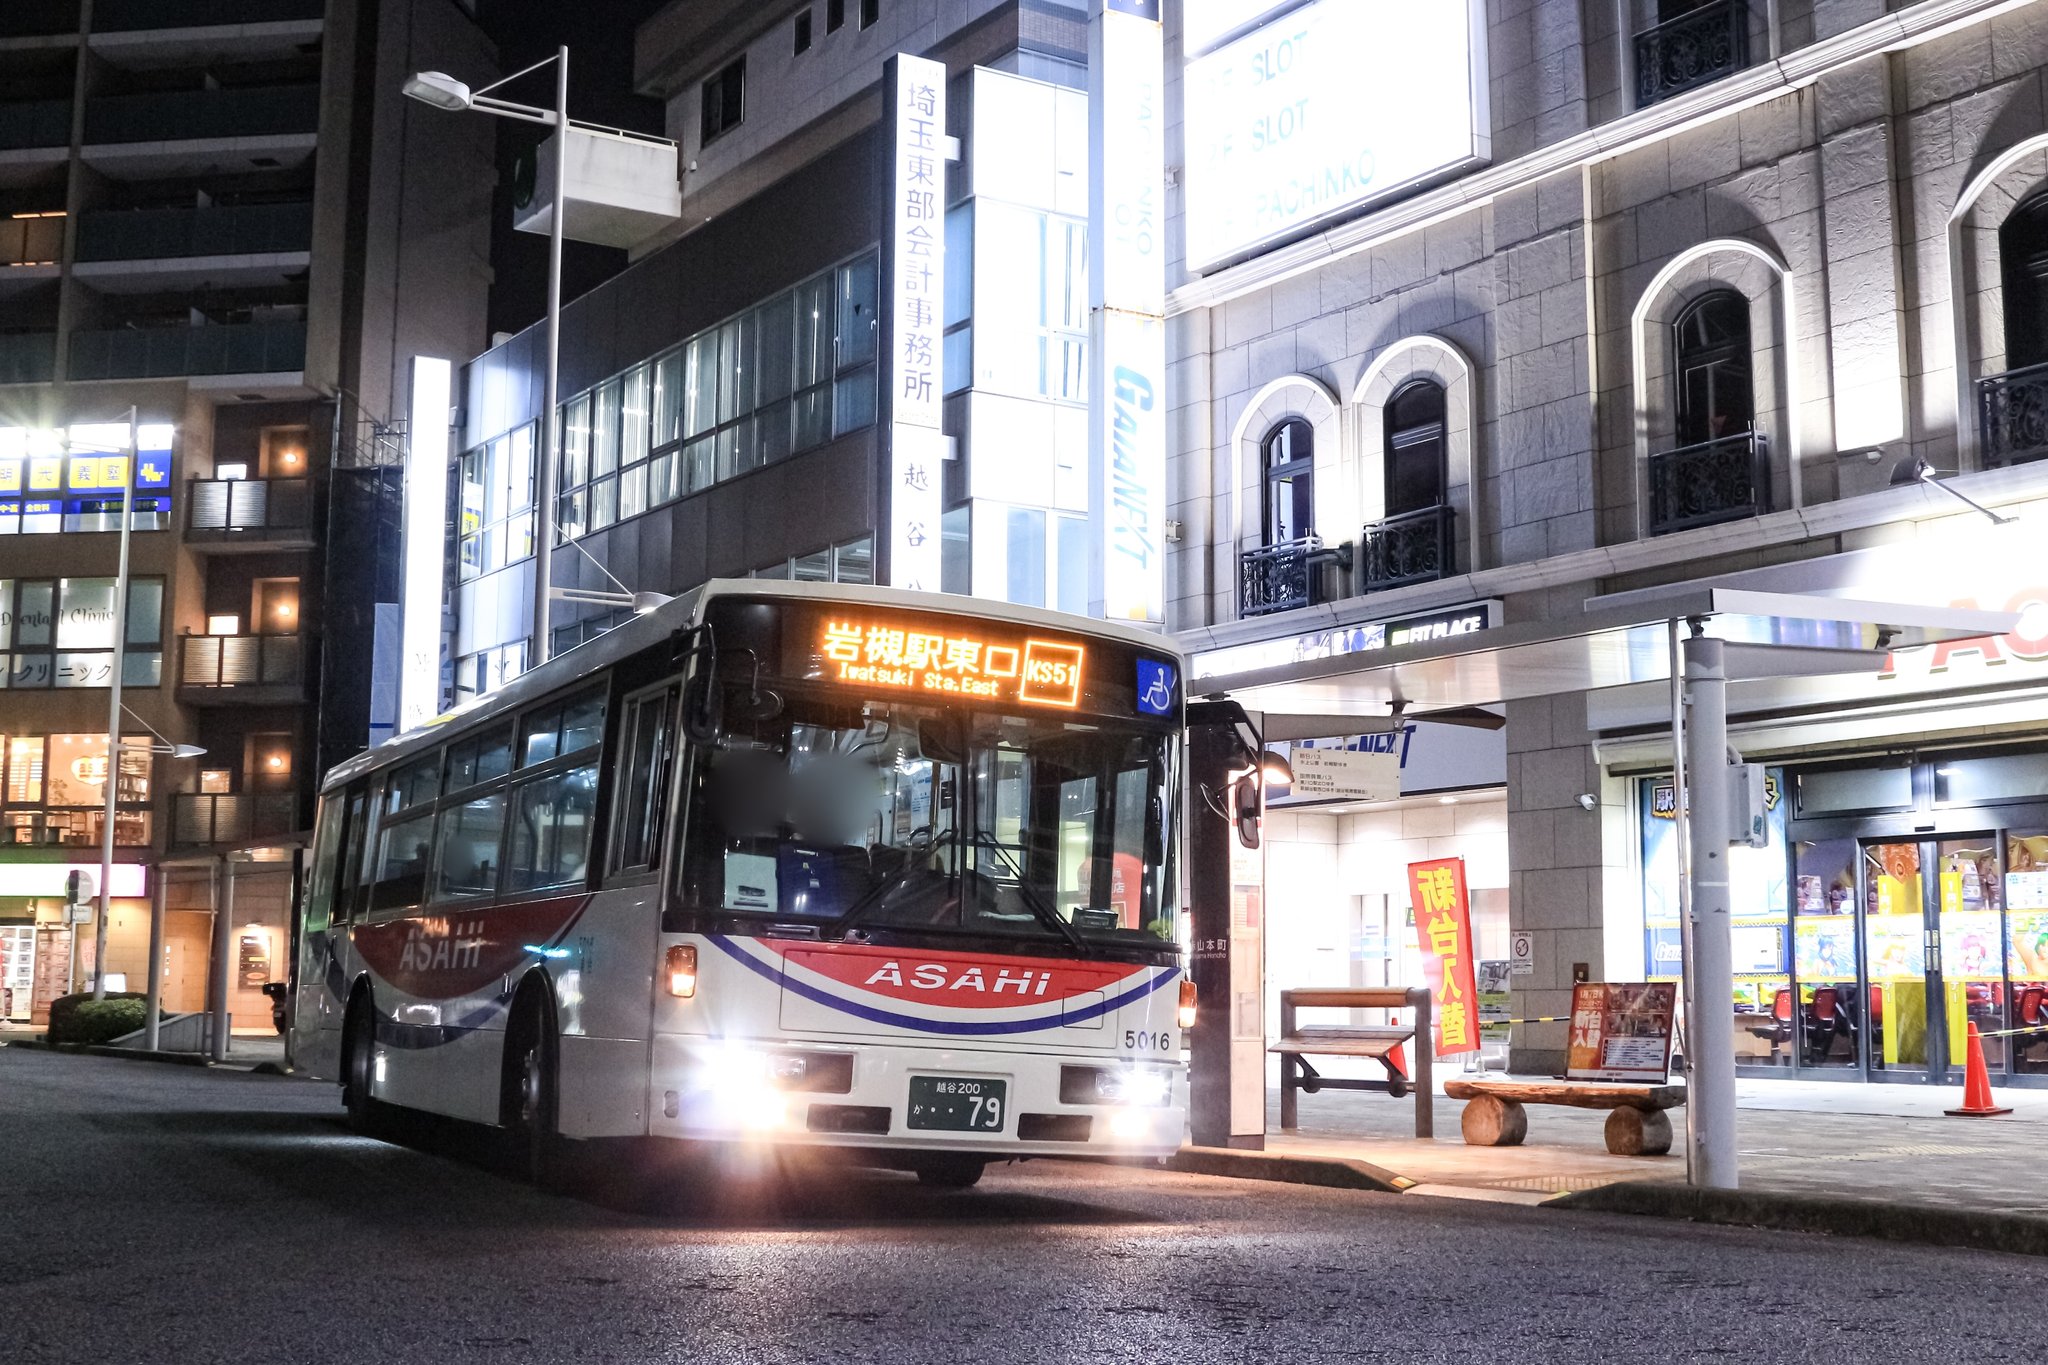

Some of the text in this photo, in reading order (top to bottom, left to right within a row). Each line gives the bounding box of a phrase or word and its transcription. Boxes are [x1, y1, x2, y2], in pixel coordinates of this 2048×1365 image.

[1250, 30, 1309, 88] SLOT
[1250, 97, 1309, 153] SLOT
[1252, 147, 1377, 228] PACHINKO
[904, 82, 936, 403] 埼玉東部会計事務所
[70, 607, 114, 623] Clinic
[1432, 616, 1481, 639] PLACE
[823, 622, 1077, 688] 岩槻駅東口 KS51
[839, 661, 914, 687] Iwatsuki
[400, 920, 485, 972] ASAHI
[864, 960, 1052, 997] ASAHI
[1124, 1030, 1170, 1051] 5016
